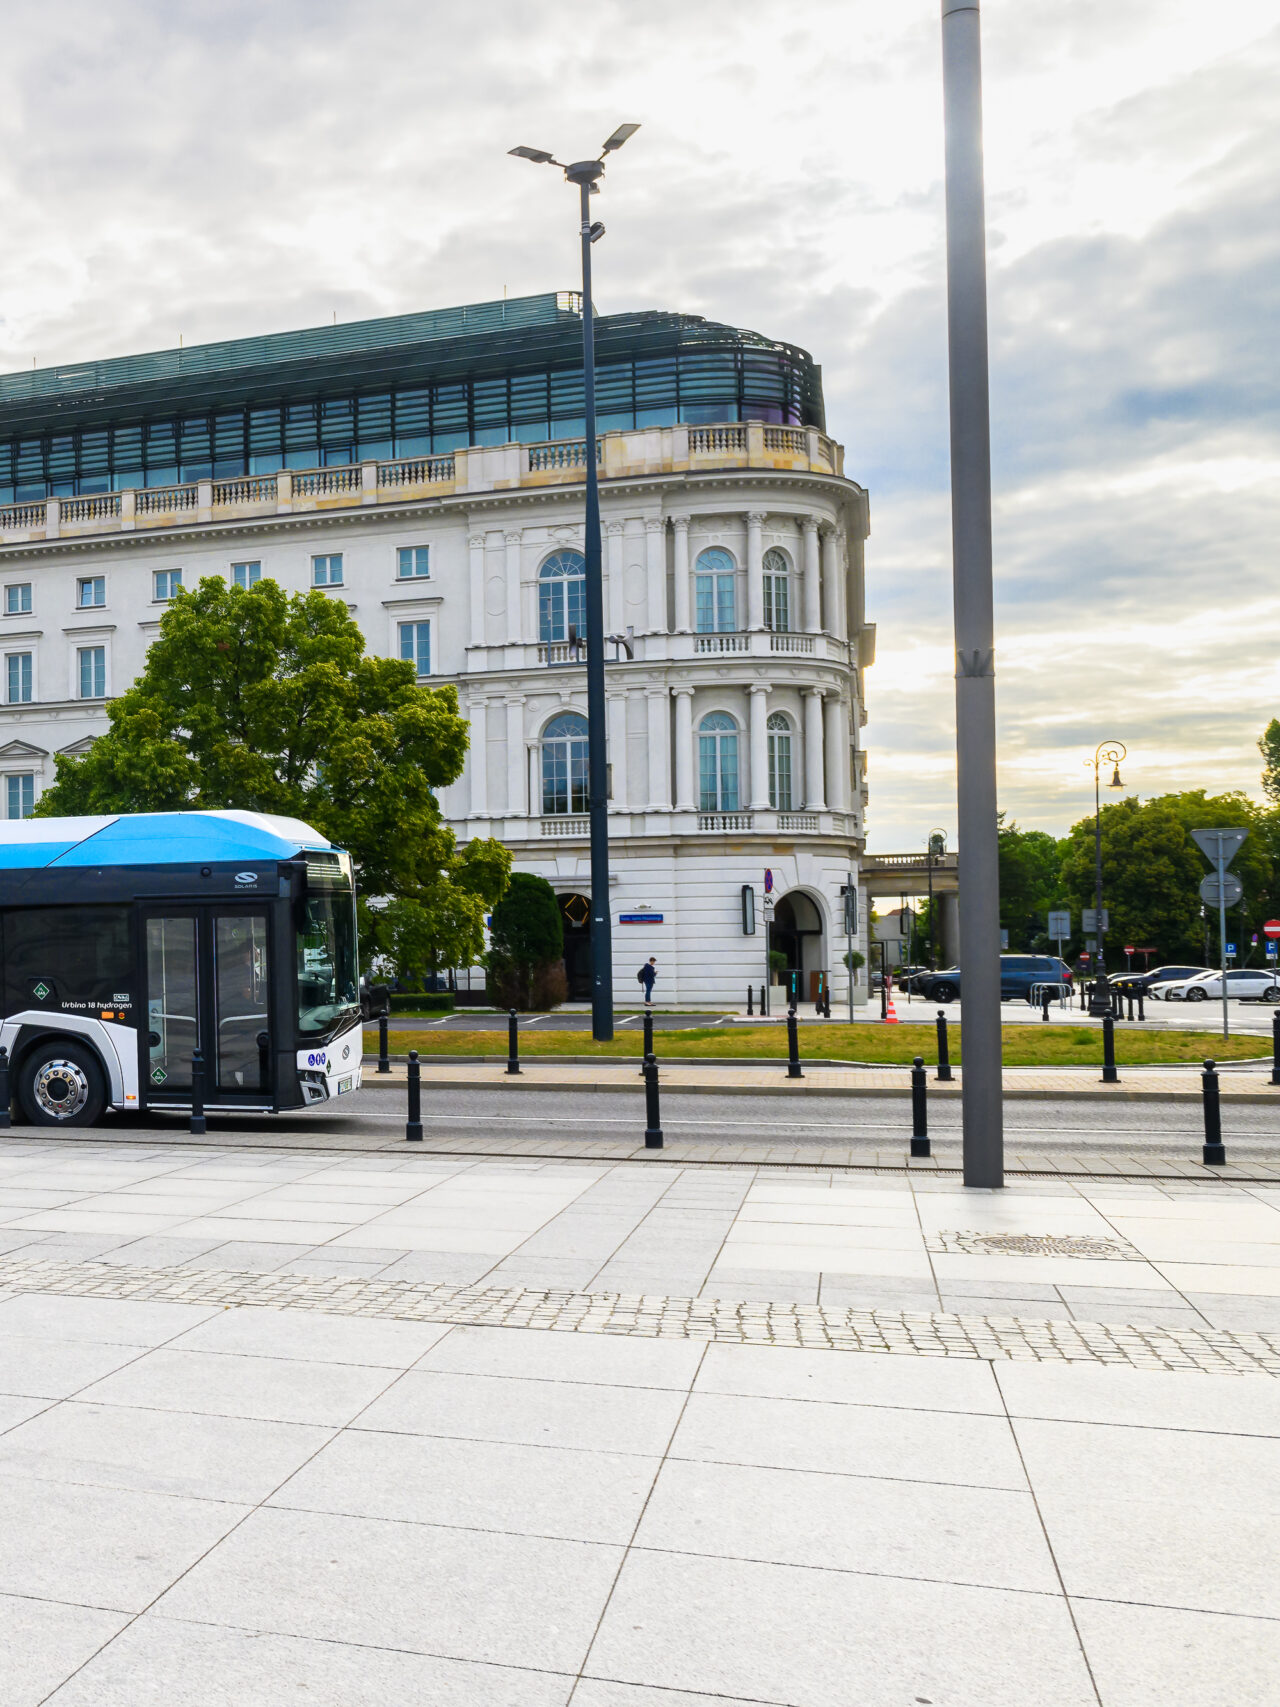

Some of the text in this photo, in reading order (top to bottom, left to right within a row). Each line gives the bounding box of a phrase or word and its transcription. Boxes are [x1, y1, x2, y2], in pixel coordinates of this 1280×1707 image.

[61, 1001, 133, 1010] Urbino 18 hydrogen
